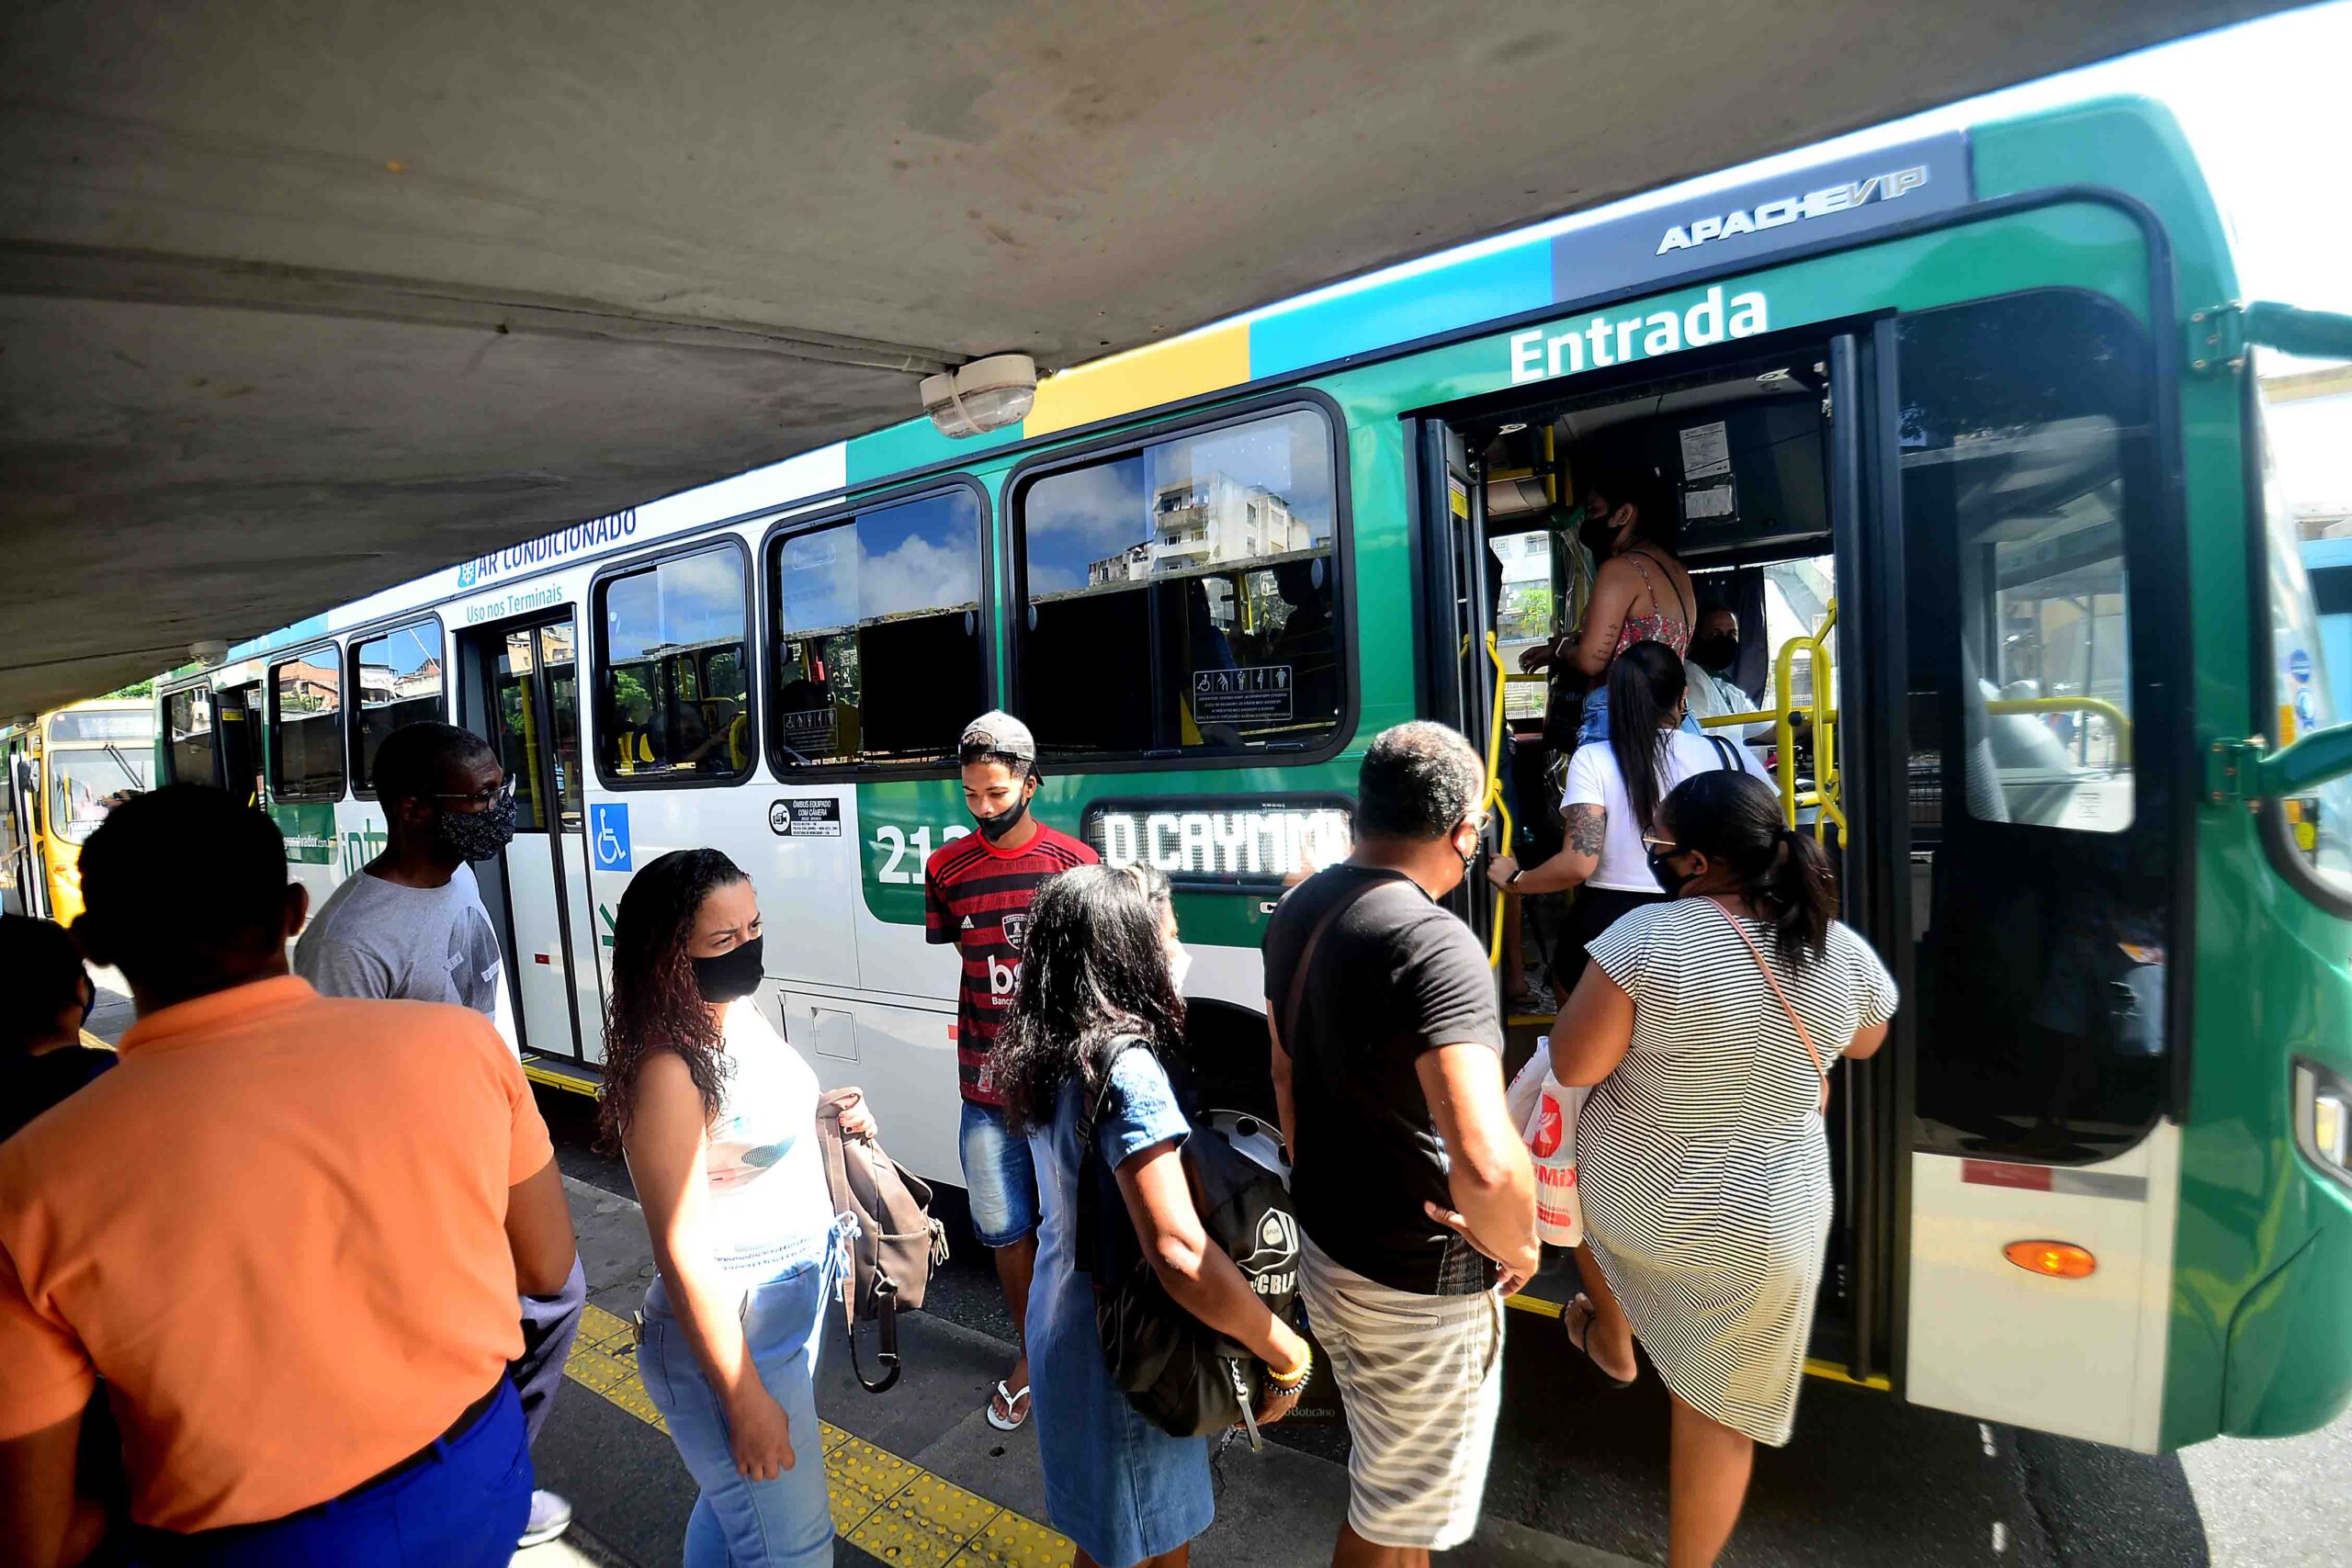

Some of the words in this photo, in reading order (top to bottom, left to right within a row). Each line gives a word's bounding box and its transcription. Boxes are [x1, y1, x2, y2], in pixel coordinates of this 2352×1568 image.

[1510, 286, 1768, 384] Entrada
[478, 554, 498, 578] AR
[504, 506, 636, 570] CONDICIONADO
[467, 605, 485, 623] Uso
[487, 601, 504, 618] nos
[507, 582, 562, 614] Terminais
